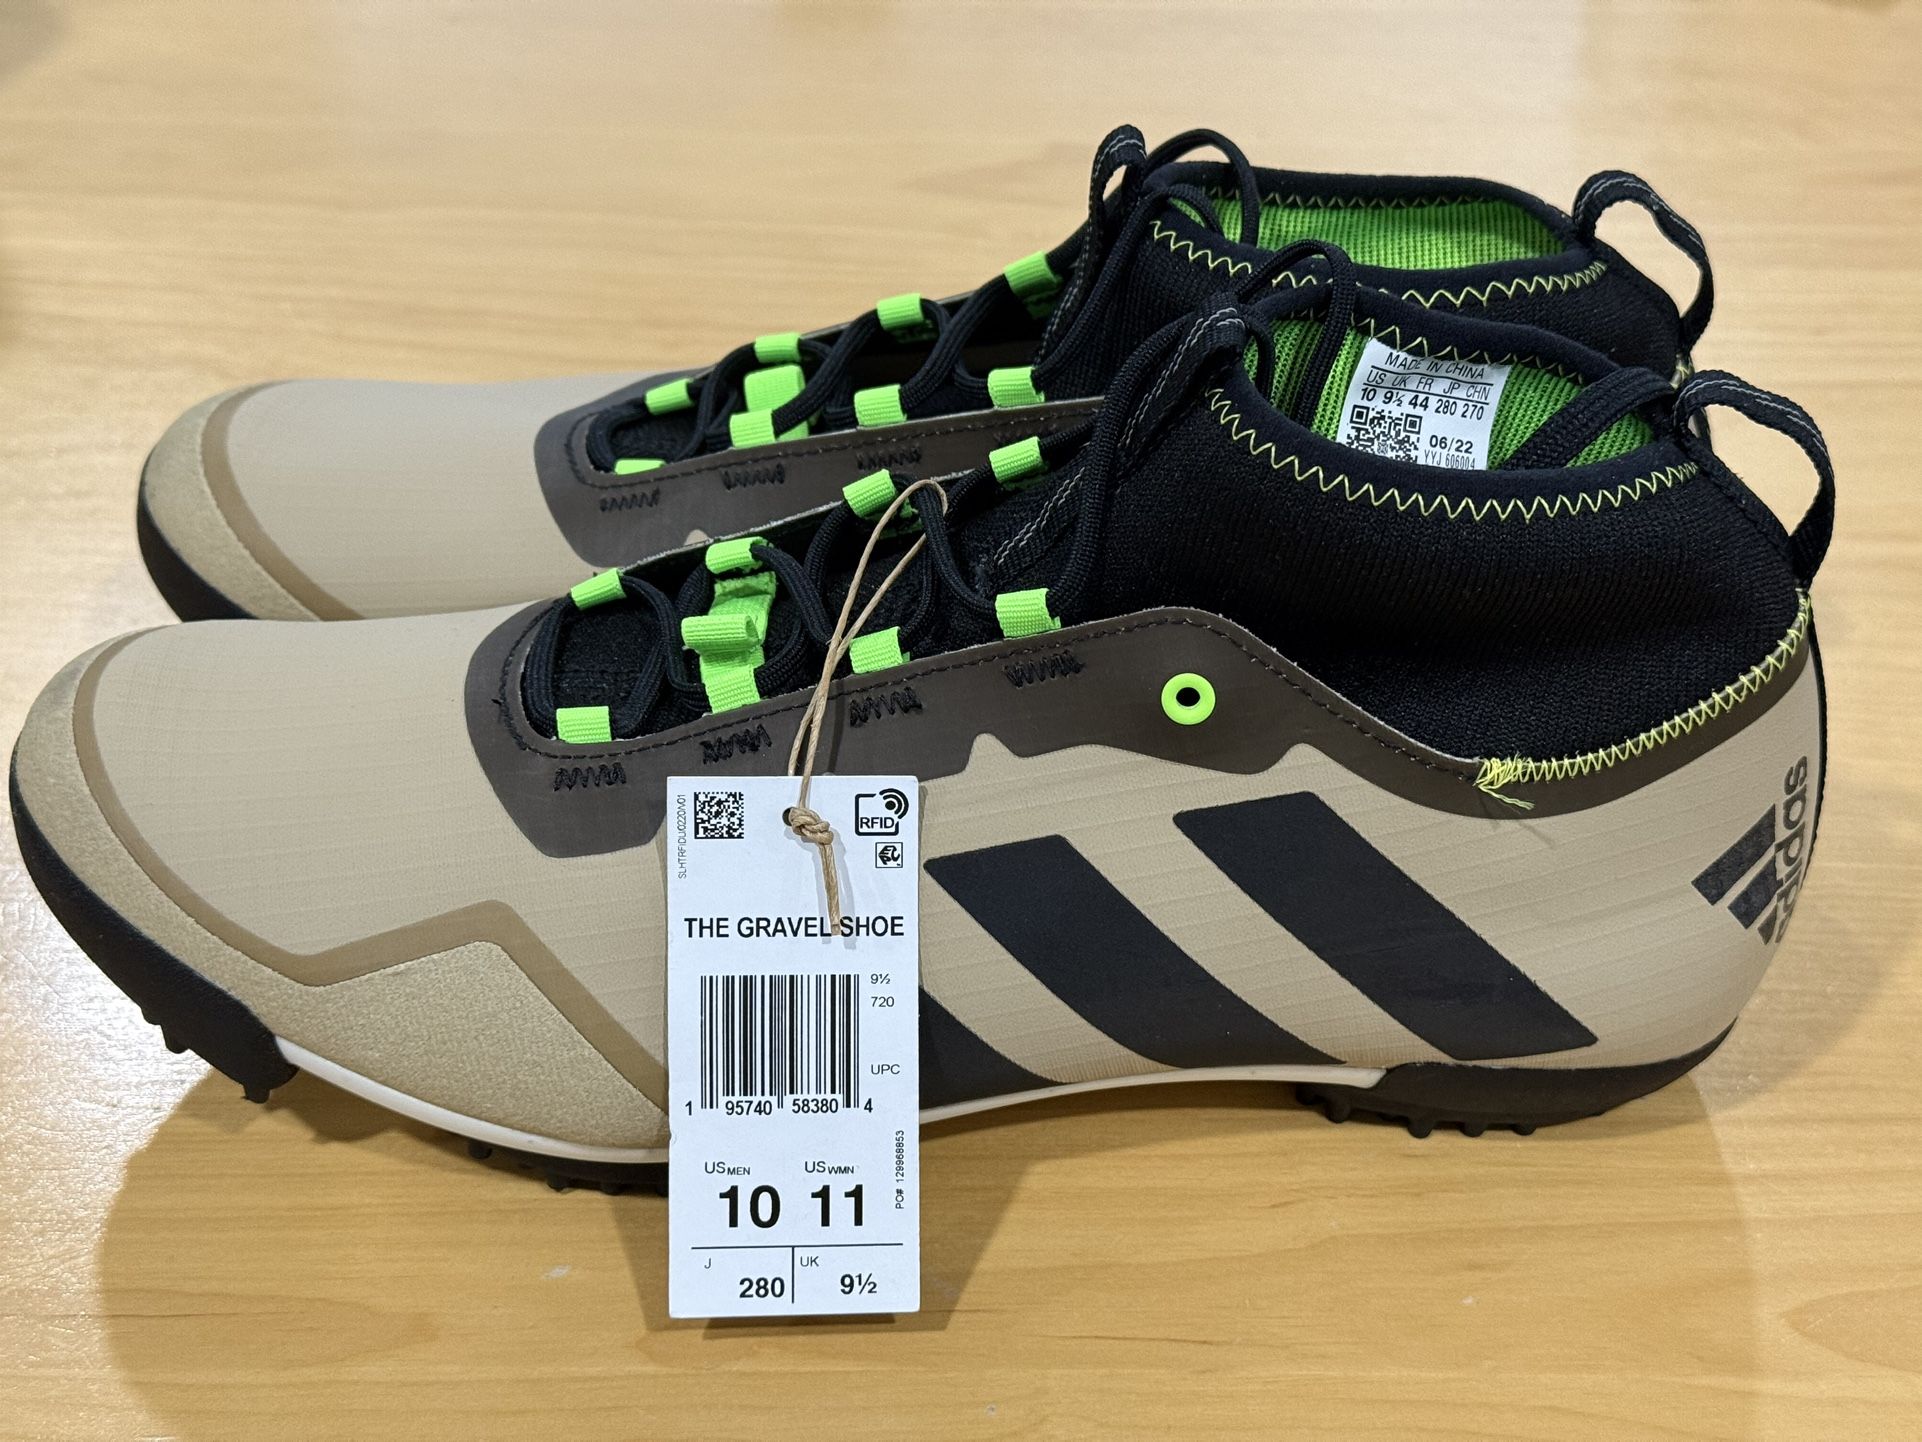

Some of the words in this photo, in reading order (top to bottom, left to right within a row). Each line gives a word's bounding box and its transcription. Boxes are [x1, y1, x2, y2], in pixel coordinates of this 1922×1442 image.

[1385, 352, 1425, 371] MADE
[1426, 359, 1441, 373] IN
[1446, 363, 1485, 379] CHINA
[1366, 369, 1387, 385] US
[1392, 374, 1409, 389] UK
[1416, 376, 1435, 392] FR
[1443, 381, 1461, 395] JP
[1466, 384, 1491, 401] CHN
[1361, 387, 1377, 402] 10
[1408, 394, 1430, 410] 44
[1435, 398, 1457, 416] 280
[1461, 403, 1484, 421] 270
[1429, 434, 1474, 454] 06/22
[1424, 449, 1442, 466] YYJ
[1445, 453, 1476, 470] 606004
[859, 816, 895, 830] RFID
[684, 917, 730, 938] THE
[737, 916, 832, 938] GRAVEL
[840, 915, 905, 938] SHOE
[870, 996, 895, 1008] 720
[870, 1063, 901, 1075] UPC
[684, 1100, 693, 1116] 1
[725, 1100, 773, 1116] 95740
[791, 1098, 839, 1114] 58380
[863, 1098, 873, 1113] 4
[895, 1130, 905, 1183] 129968853
[719, 1184, 781, 1229] 10
[811, 1183, 864, 1227] 11
[895, 1188, 904, 1210] PO#
[704, 1258, 712, 1270] J
[800, 1255, 820, 1267] UK
[739, 1277, 785, 1298] 280
[840, 1273, 878, 1295] 9½
